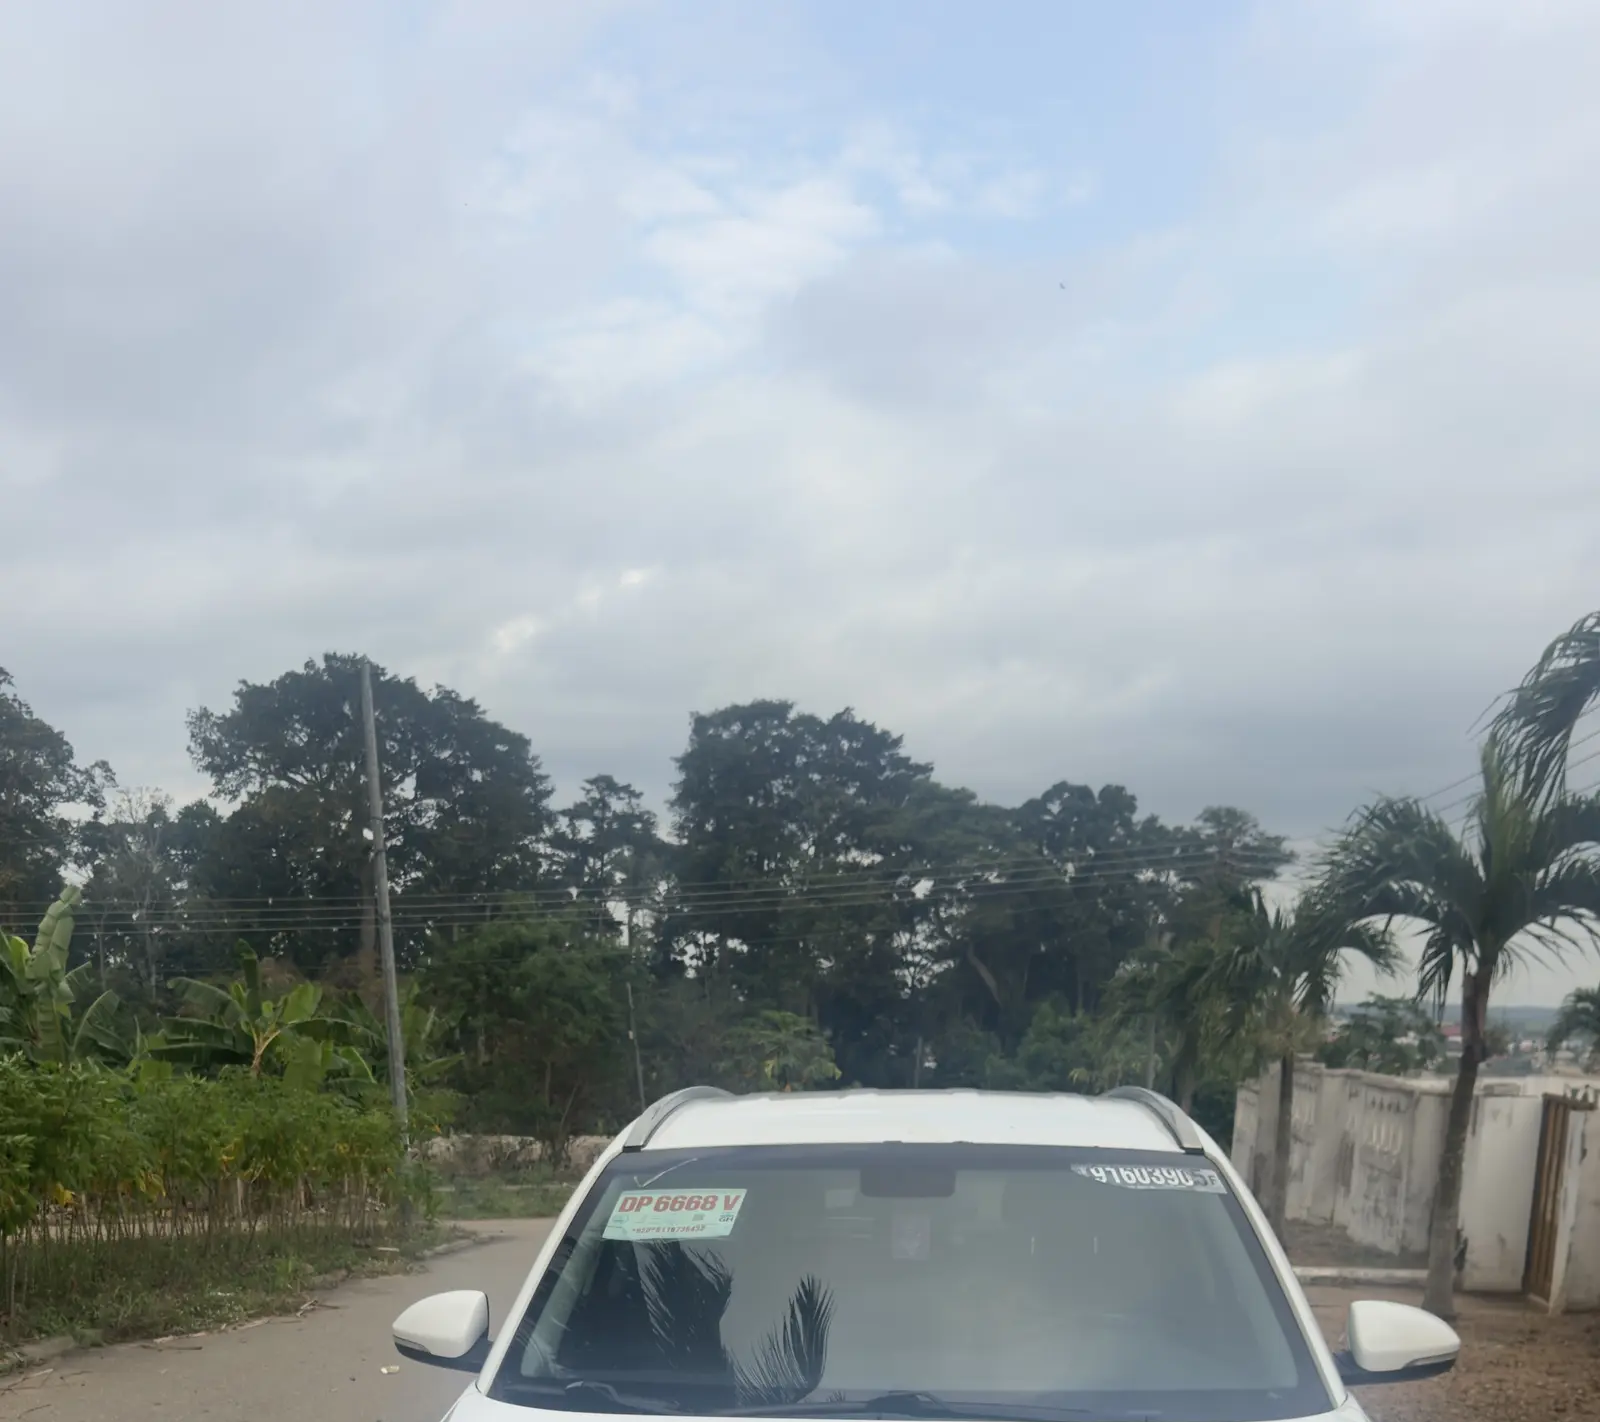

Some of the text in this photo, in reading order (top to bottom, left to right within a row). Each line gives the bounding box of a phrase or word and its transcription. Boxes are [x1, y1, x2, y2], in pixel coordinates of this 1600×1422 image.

[618, 1194, 741, 1213] DP 6668 V
